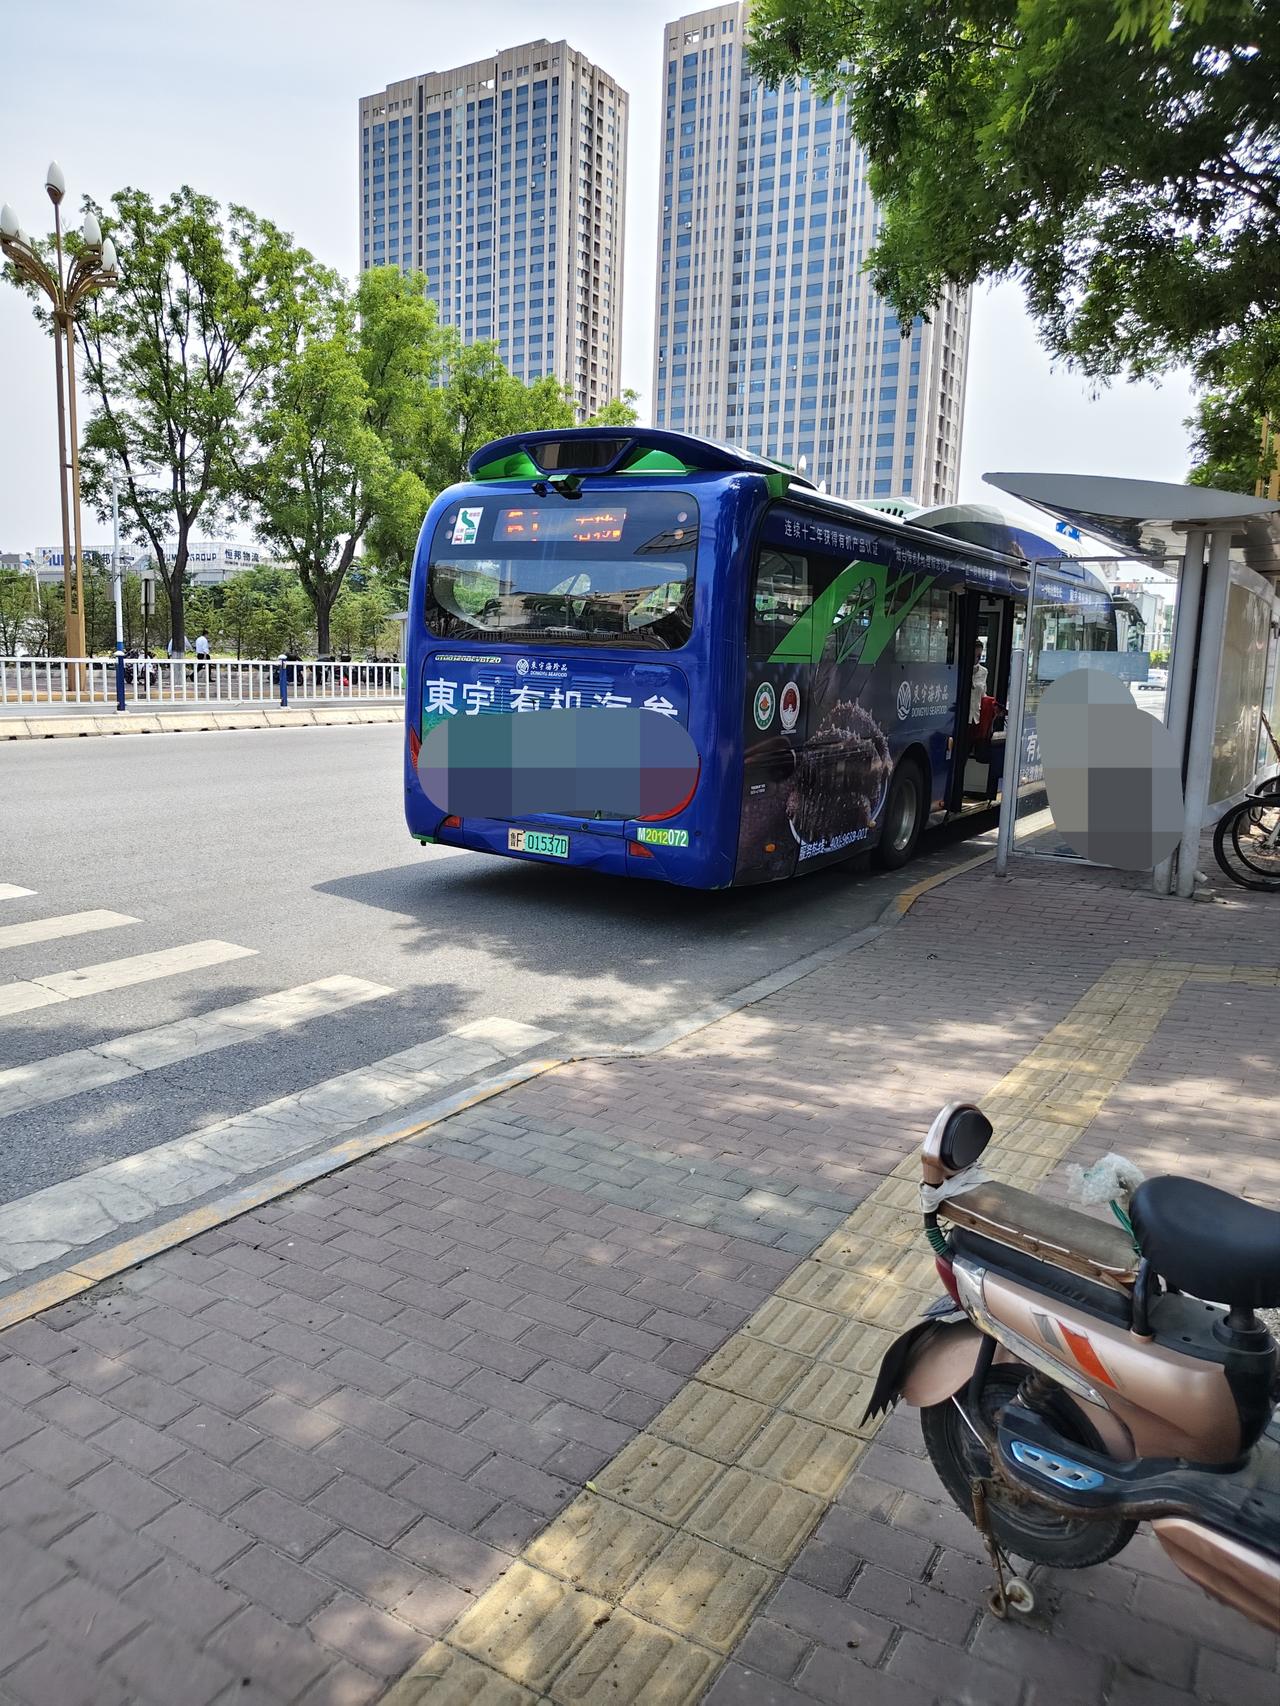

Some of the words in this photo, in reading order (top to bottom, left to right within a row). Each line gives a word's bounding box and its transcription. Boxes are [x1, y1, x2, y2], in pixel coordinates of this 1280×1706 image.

[784, 519, 879, 556] 连续十二年获得有机产品认证
[224, 549, 259, 562] 恒邦物流
